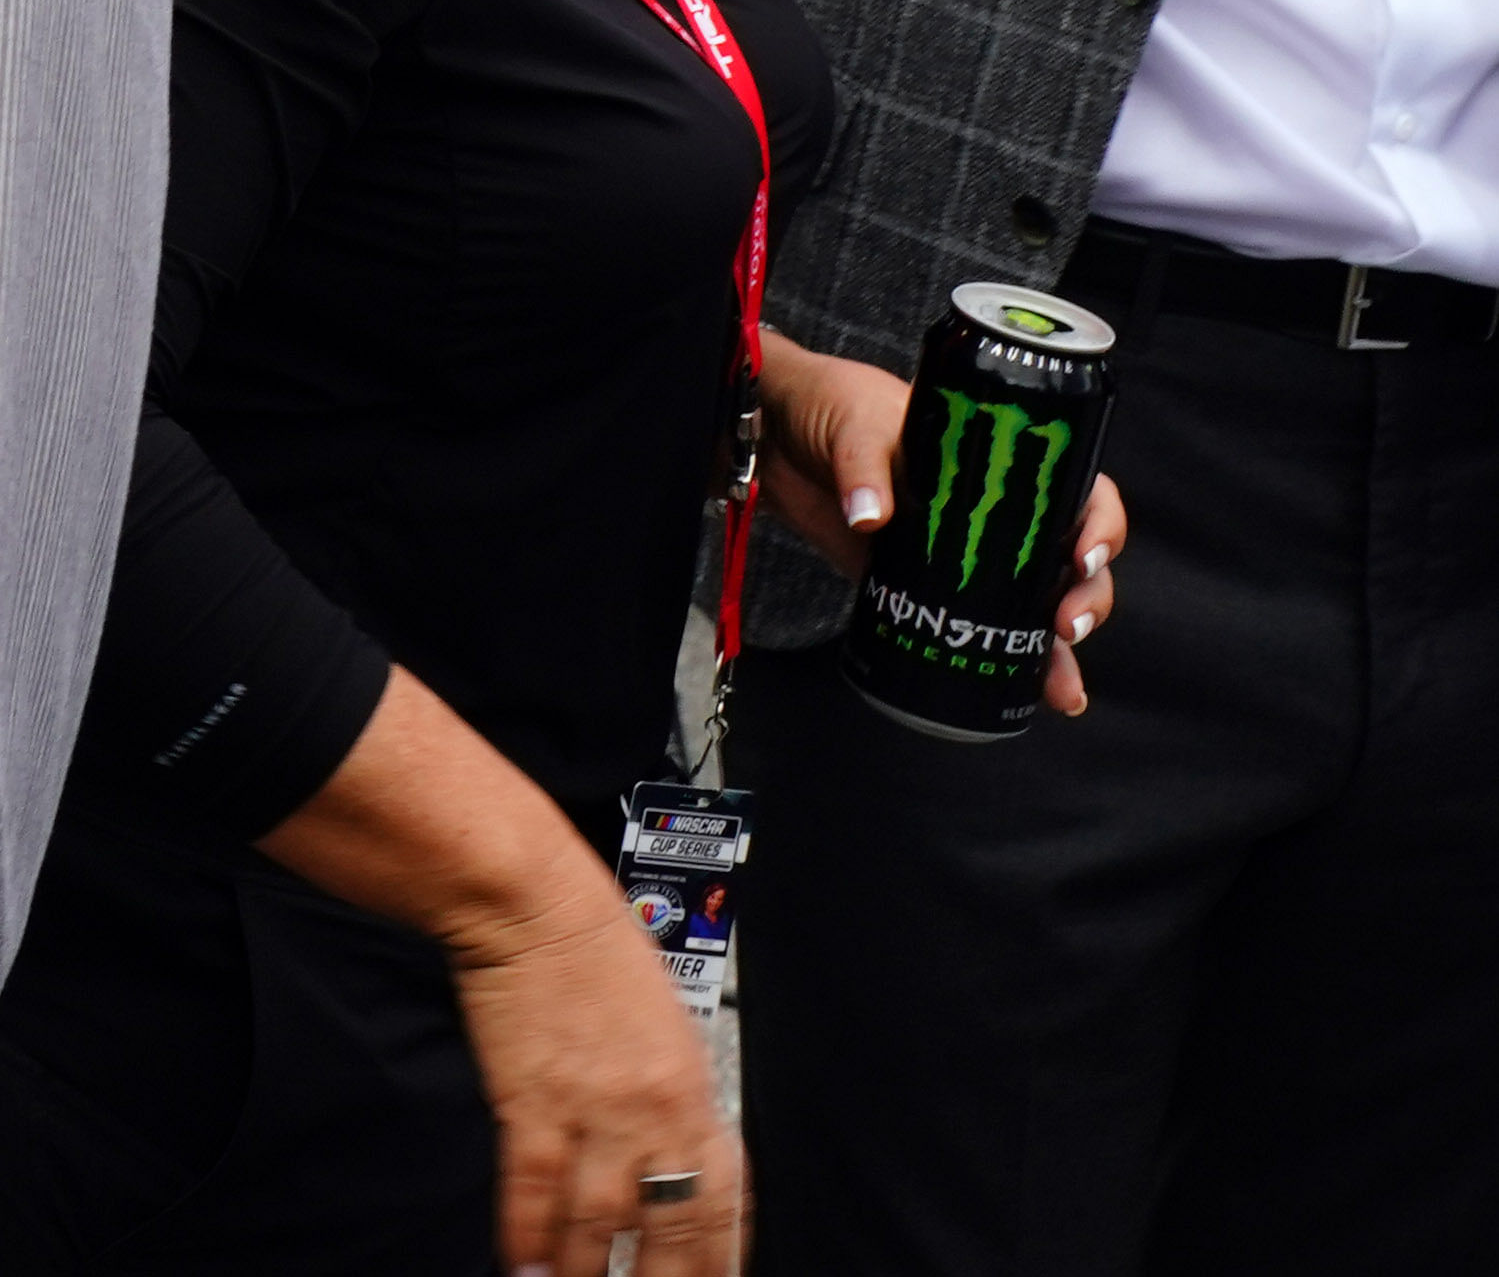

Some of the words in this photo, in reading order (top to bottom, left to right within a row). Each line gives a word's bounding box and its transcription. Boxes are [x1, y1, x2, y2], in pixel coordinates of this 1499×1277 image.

[978, 336, 1074, 375] TAURINE
[865, 576, 1047, 655] MONSTER
[876, 622, 1020, 677] ENERGY
[672, 815, 727, 836] NASCAR
[650, 837, 676, 854] CUP
[677, 838, 723, 858] SERIES
